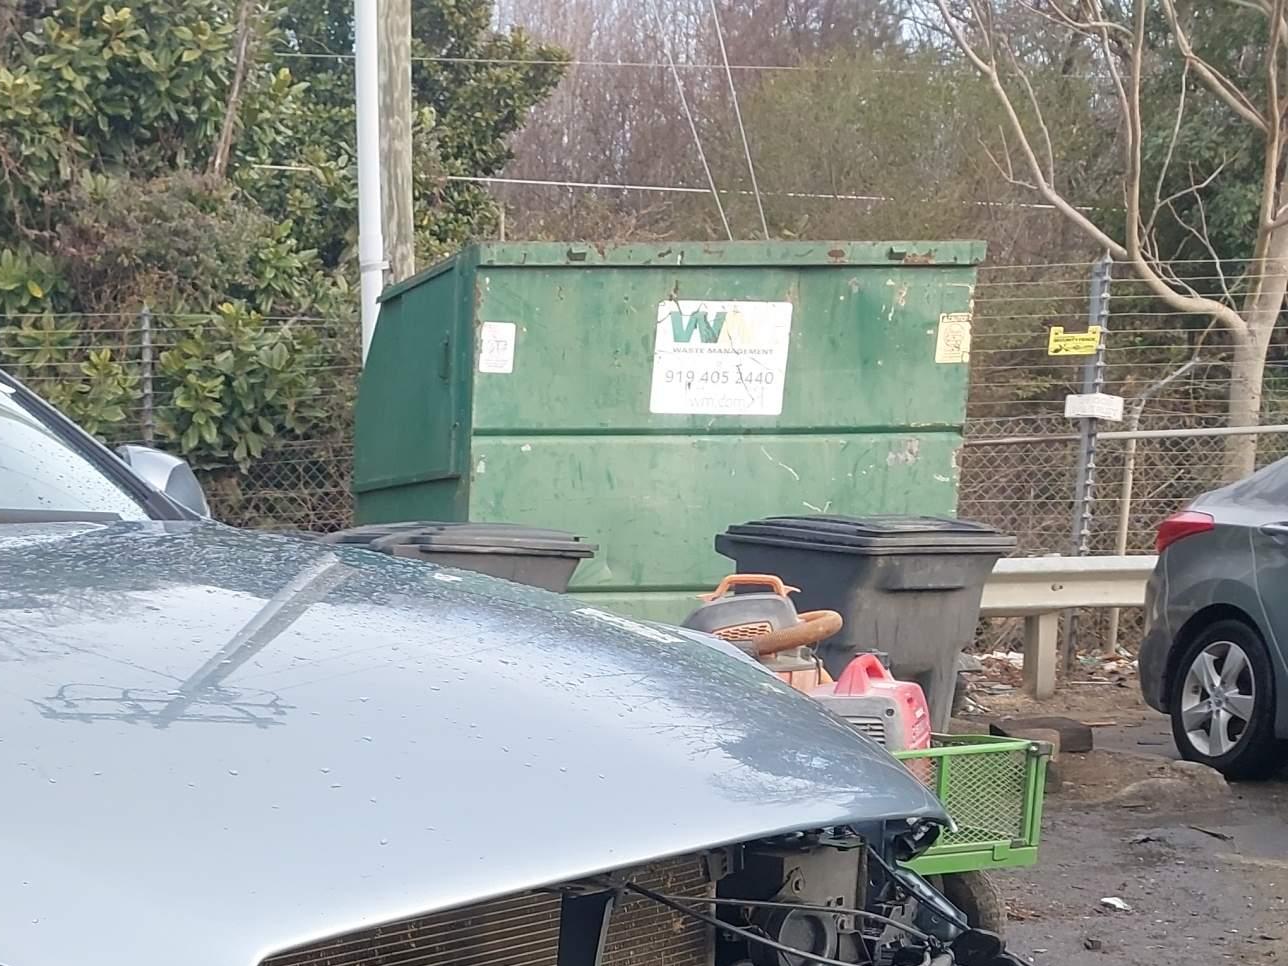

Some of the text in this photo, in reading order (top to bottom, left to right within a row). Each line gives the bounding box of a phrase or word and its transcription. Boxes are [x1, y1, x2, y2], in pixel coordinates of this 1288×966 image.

[707, 347, 774, 355] MANAGEMENT
[665, 370, 695, 383] 919
[700, 371, 729, 384] 405
